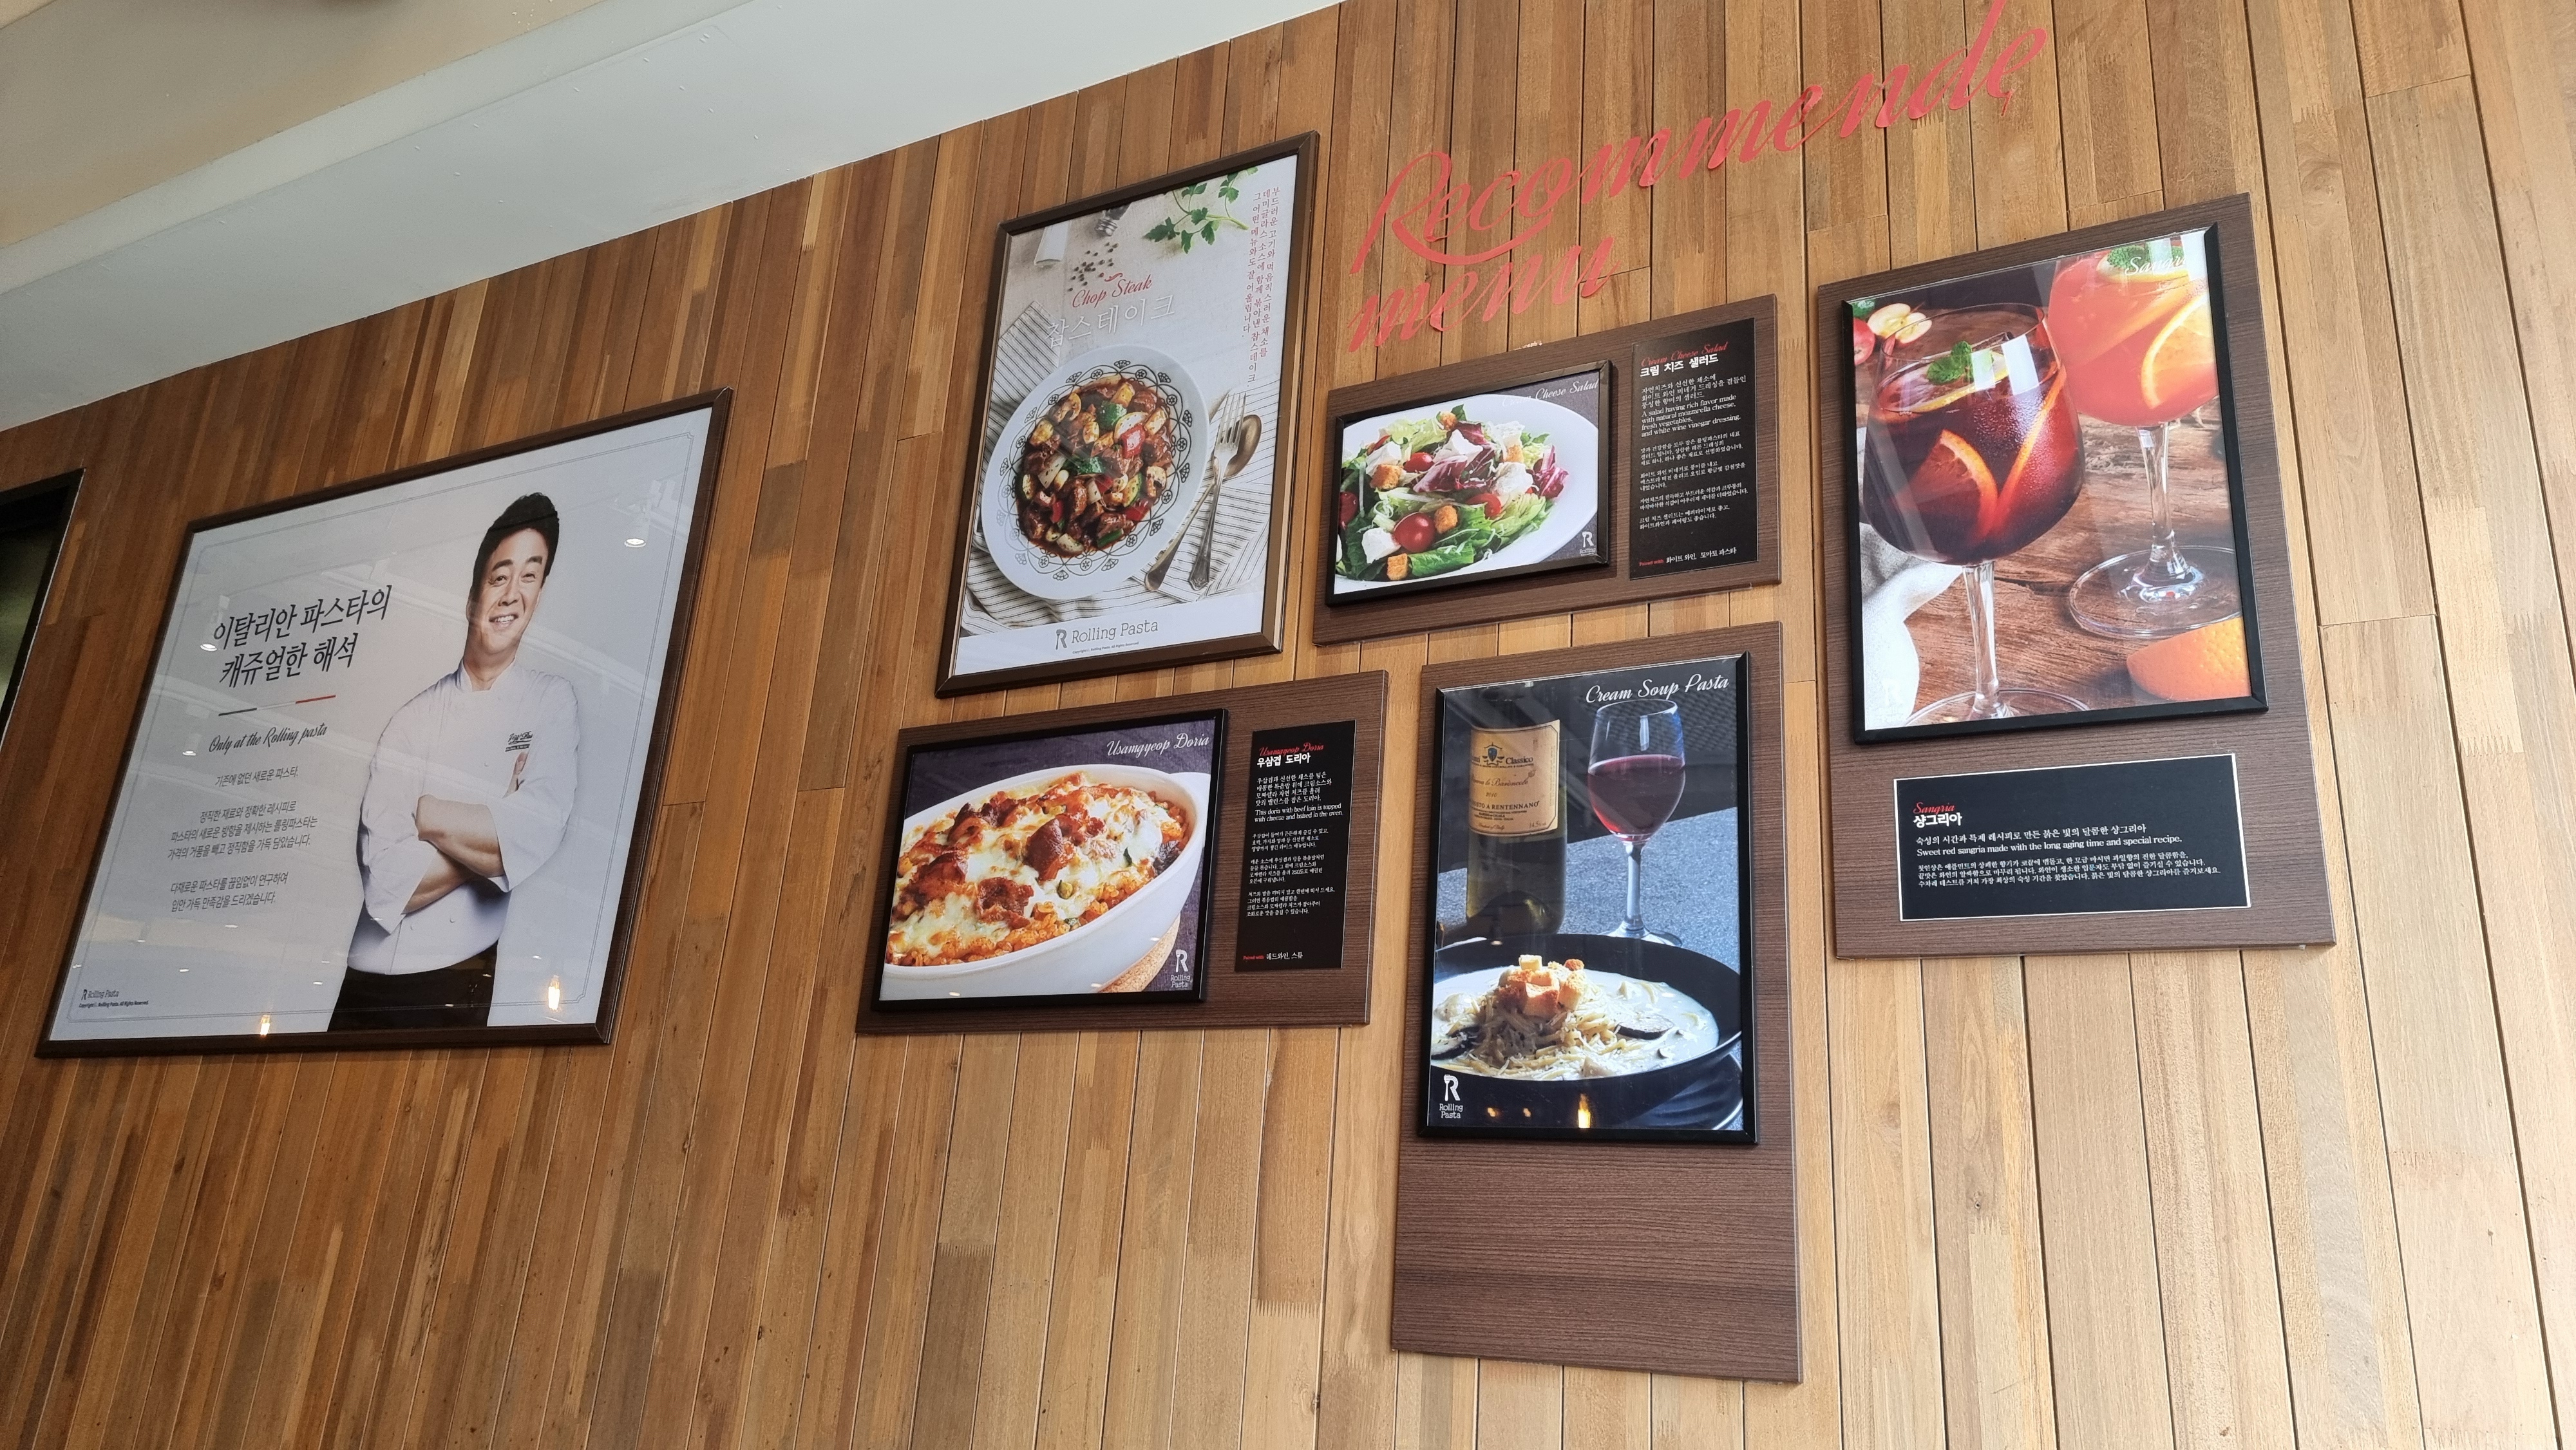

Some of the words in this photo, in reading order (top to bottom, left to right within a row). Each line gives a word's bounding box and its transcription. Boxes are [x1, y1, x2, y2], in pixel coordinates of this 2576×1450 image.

[1253, 193, 1261, 201] 그
[1269, 186, 1280, 227] 부드러운
[1252, 204, 1260, 224] 어떤
[1260, 189, 1271, 238] 데미글라스
[1248, 227, 1259, 267] 메뉴와도
[1266, 230, 1276, 259] 고기와
[1257, 243, 1266, 271] 소스에
[1247, 270, 1256, 281] 잘
[1256, 275, 1264, 294] 함께
[1072, 287, 1107, 308] Chop
[1112, 274, 1153, 297] Steak
[1262, 263, 1274, 325] 먹음직스러운
[1347, 237, 1622, 353] menu
[1045, 294, 1175, 348] 찹스테이크
[1259, 326, 1269, 357] 채소를
[1640, 357, 1667, 366] Cream
[1671, 350, 1699, 361] Cheese
[1701, 341, 1728, 354] Salad
[1640, 365, 1660, 377] 크림
[1664, 361, 1683, 372] 치즈
[1689, 353, 1719, 368] 샐러드
[1535, 388, 1566, 399] Cheese
[1569, 379, 1599, 393] Salad
[1642, 415, 1654, 424] with
[1656, 412, 1677, 422] natural
[1678, 407, 1711, 417] mozzarella
[1649, 408, 1663, 416] salad
[1665, 404, 1685, 413] having
[1700, 397, 1718, 406] flavor
[1719, 394, 1736, 402] made
[1689, 420, 1710, 429] vinegar
[214, 604, 298, 650] 이탈리안
[300, 585, 393, 634] 파스타의
[1071, 627, 1117, 644] Rolling
[1120, 619, 1159, 636] Pasta
[219, 643, 308, 688] 캐쥬얼한
[313, 632, 359, 672] 해석
[1586, 685, 1633, 703] Cream
[1637, 679, 1680, 700] Soup
[1684, 673, 1730, 693] Pasta
[209, 735, 231, 755] Only
[233, 736, 247, 749] at
[248, 731, 261, 746] the
[263, 726, 299, 748] Rolling
[298, 722, 328, 744] pasta
[1106, 740, 1170, 758] Usamgyeop
[1173, 733, 1209, 749] Doria
[1302, 742, 1324, 753] Doria
[1257, 755, 1282, 767] 우삼겹
[1285, 753, 1311, 764] 도리아
[1506, 756, 1533, 765] Classico
[215, 775, 236, 787] 기존에
[237, 772, 252, 785] 없던
[253, 769, 274, 782] 새로운
[276, 766, 298, 778] 파스타.
[200, 809, 222, 823] 정직한
[222, 807, 243, 820] 재료와
[245, 804, 267, 818] 정확한
[267, 801, 297, 814] 레시피로
[1913, 802, 1956, 815] Sangria
[1913, 812, 1963, 828] 샹그리아
[171, 829, 198, 843] 파스타의
[199, 826, 220, 839] 새로운
[222, 824, 243, 837] 방향을
[243, 821, 272, 834] 제시하는
[274, 816, 318, 831] 롤링파스타는
[1942, 834, 1967, 845] 시간과
[1988, 831, 2022, 841] 레시피로
[2023, 830, 2041, 840] 만든
[2062, 827, 2079, 838] 빛의
[2110, 824, 2147, 835] 샹그리아
[168, 847, 189, 860] 가격의
[189, 844, 211, 858] 거품을
[227, 839, 256, 855] 정직함을
[256, 838, 272, 851] 가득
[272, 834, 310, 849] 담았습니다.
[1917, 847, 1941, 856] Sweet
[1942, 847, 1956, 856] red
[1958, 845, 1985, 854] sangria
[1987, 843, 2009, 852] made
[2011, 842, 2027, 851] with
[2029, 842, 2042, 851] the
[2044, 842, 2061, 851] long
[2063, 840, 2085, 849] aging
[2086, 838, 2104, 847] time
[2106, 838, 2121, 847] and
[2123, 836, 2152, 847] special
[2153, 834, 2183, 844] recipe.
[171, 880, 198, 894] 다채로운
[199, 877, 228, 892] 파스타를
[228, 874, 258, 890] 끊임없이
[259, 871, 289, 885] 연구하여
[171, 899, 186, 912] 입안
[186, 898, 201, 910] 가득
[202, 894, 231, 910] 만족감을
[1439, 1103, 1463, 1112] Rolling
